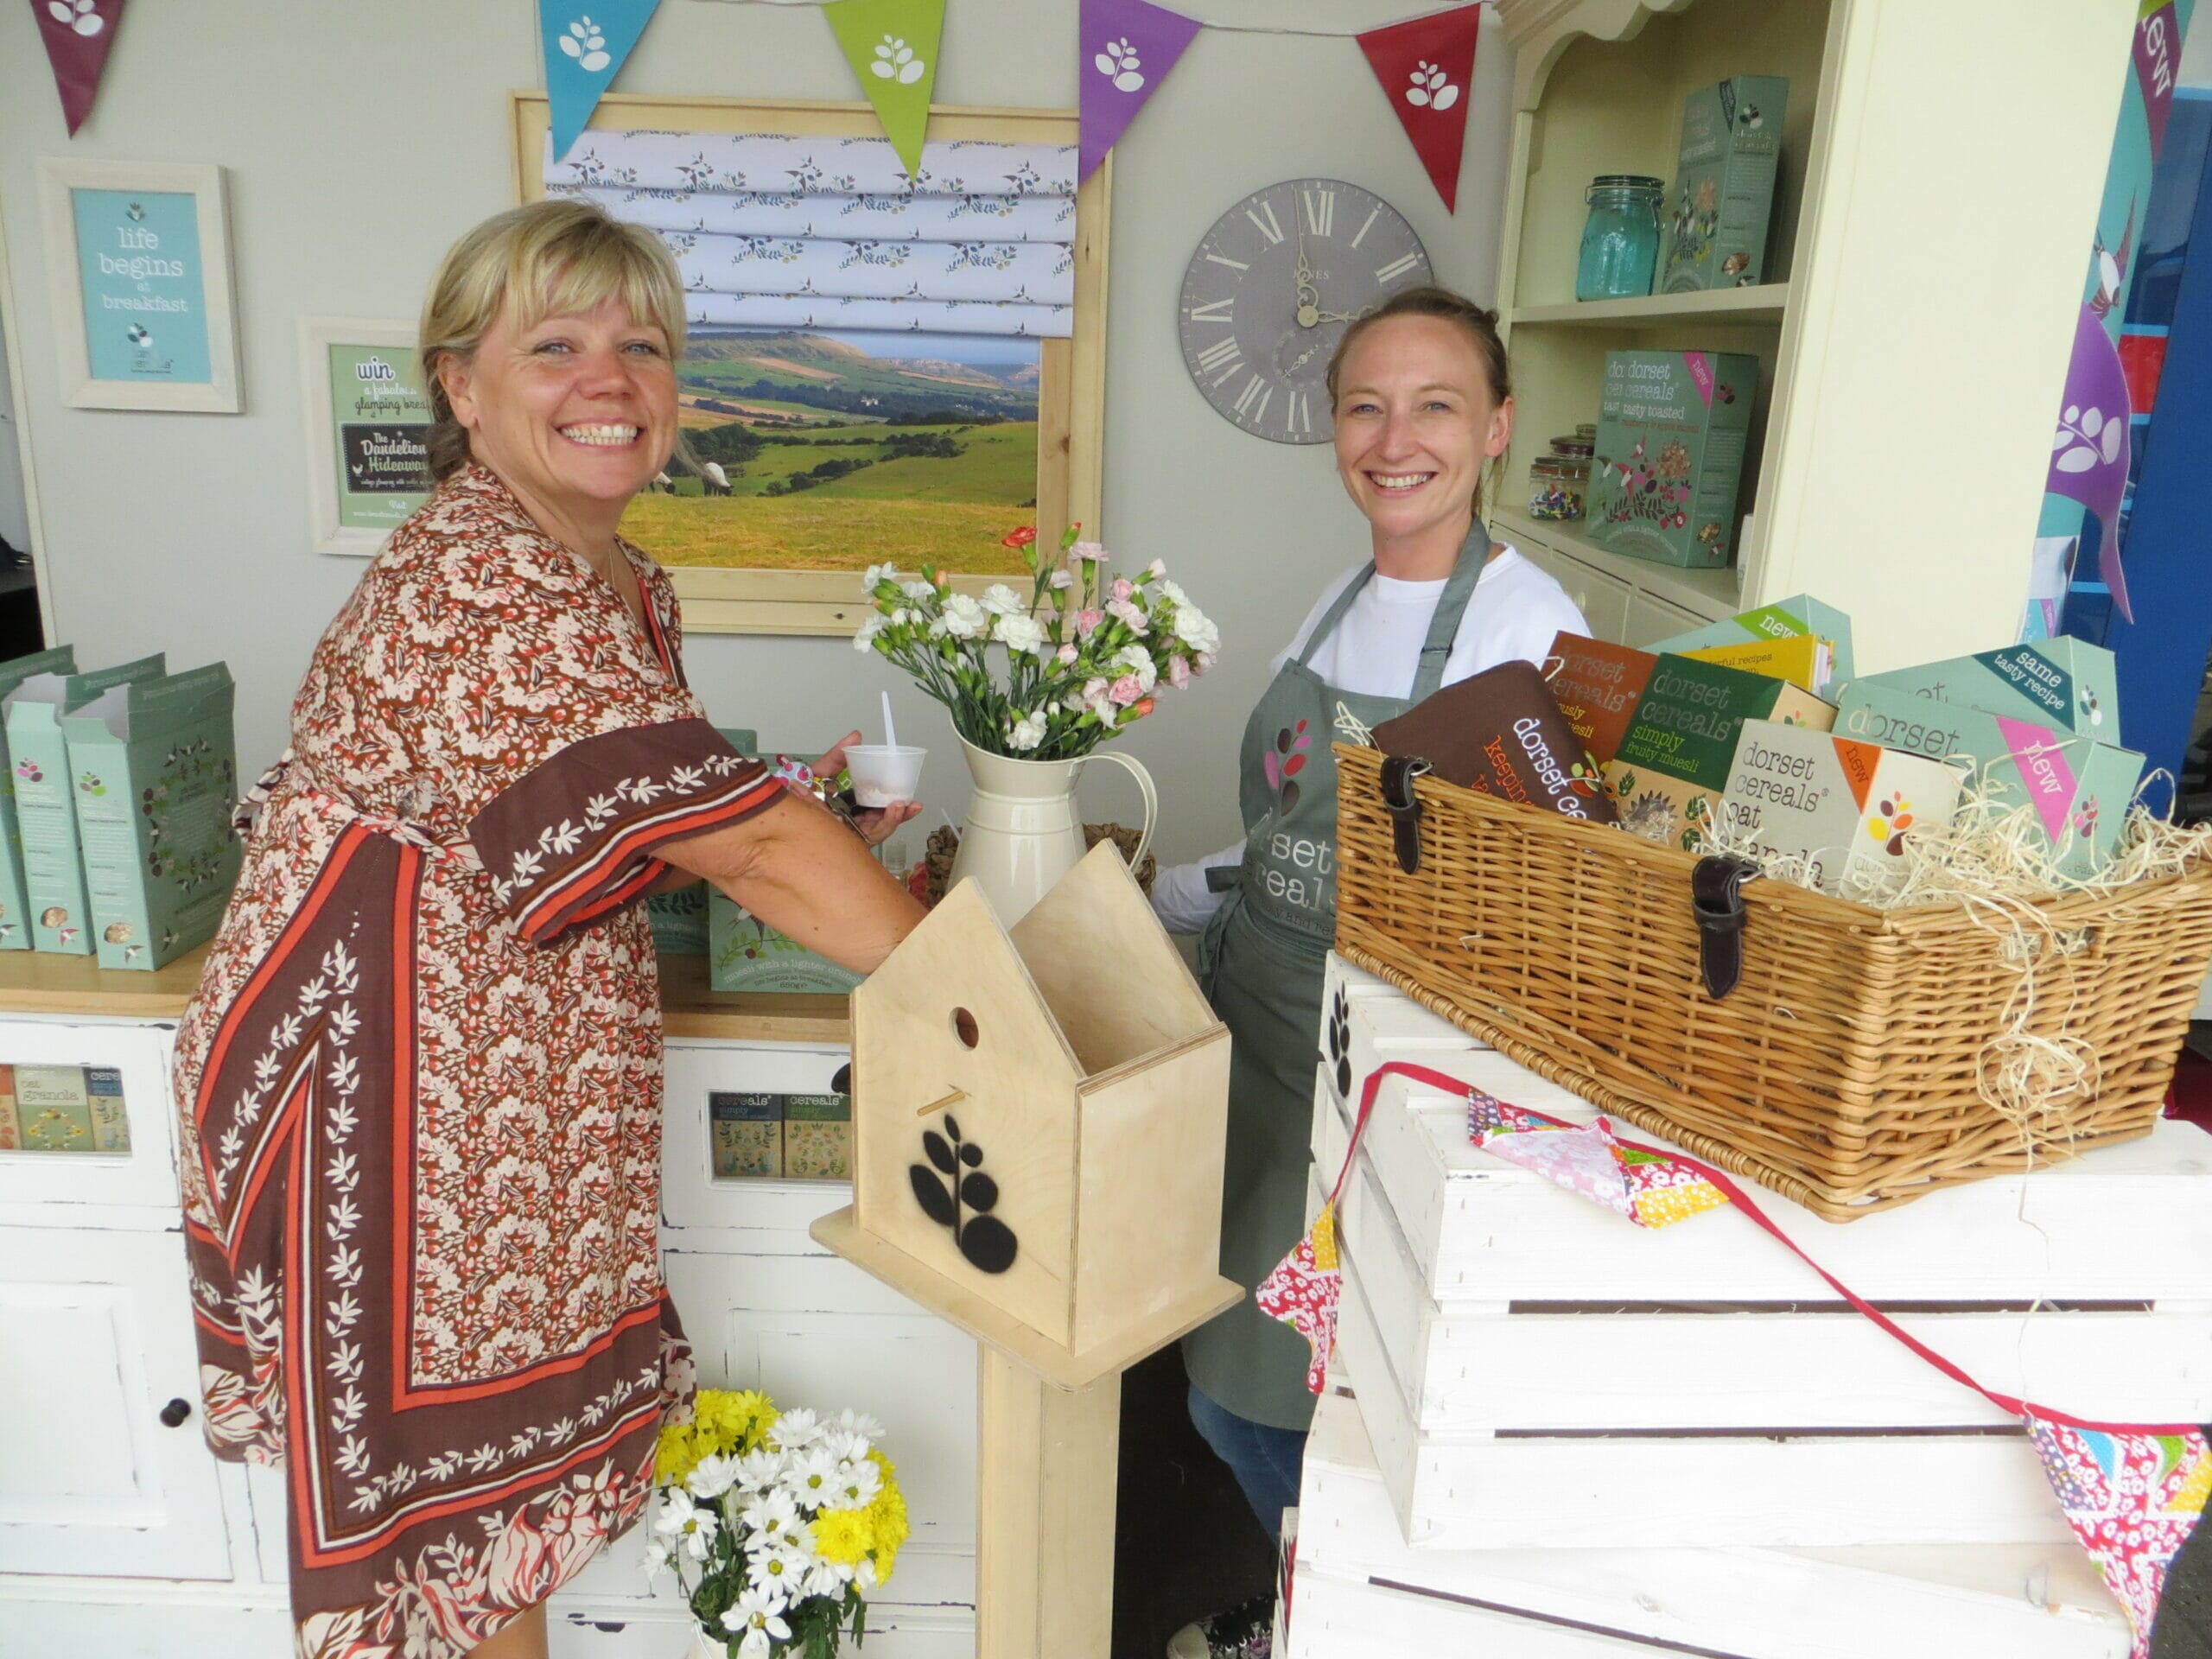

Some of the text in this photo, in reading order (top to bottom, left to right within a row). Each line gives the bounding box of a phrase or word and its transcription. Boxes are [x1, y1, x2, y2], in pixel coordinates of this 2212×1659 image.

[117, 226, 159, 250] life
[99, 252, 184, 280] begins
[102, 294, 189, 312] breakfast
[356, 355, 396, 380] win
[1628, 359, 1671, 380] dorset
[1693, 359, 1708, 386] new
[354, 397, 401, 416] glamping
[1622, 403, 1686, 421] tasty toasted
[360, 438, 428, 456] Dandelion
[373, 432, 388, 443] The
[1738, 652, 1773, 666] recipes
[2016, 652, 2063, 688] same
[1653, 669, 1732, 709] dorset
[1993, 653, 2066, 710] tasty recipe
[1632, 725, 1686, 753] simply
[1847, 702, 1961, 756] dorset
[1513, 718, 1570, 795] dorset
[1625, 741, 1700, 774] fruity muesli
[1743, 741, 1815, 781] dorset
[1845, 746, 1870, 784] new
[2024, 740, 2063, 794] new
[1726, 802, 1763, 830] oat
[724, 965, 755, 985] muesli
[757, 959, 780, 972] with
[791, 958, 826, 972] lighter
[22, 1089, 79, 1102] granola
